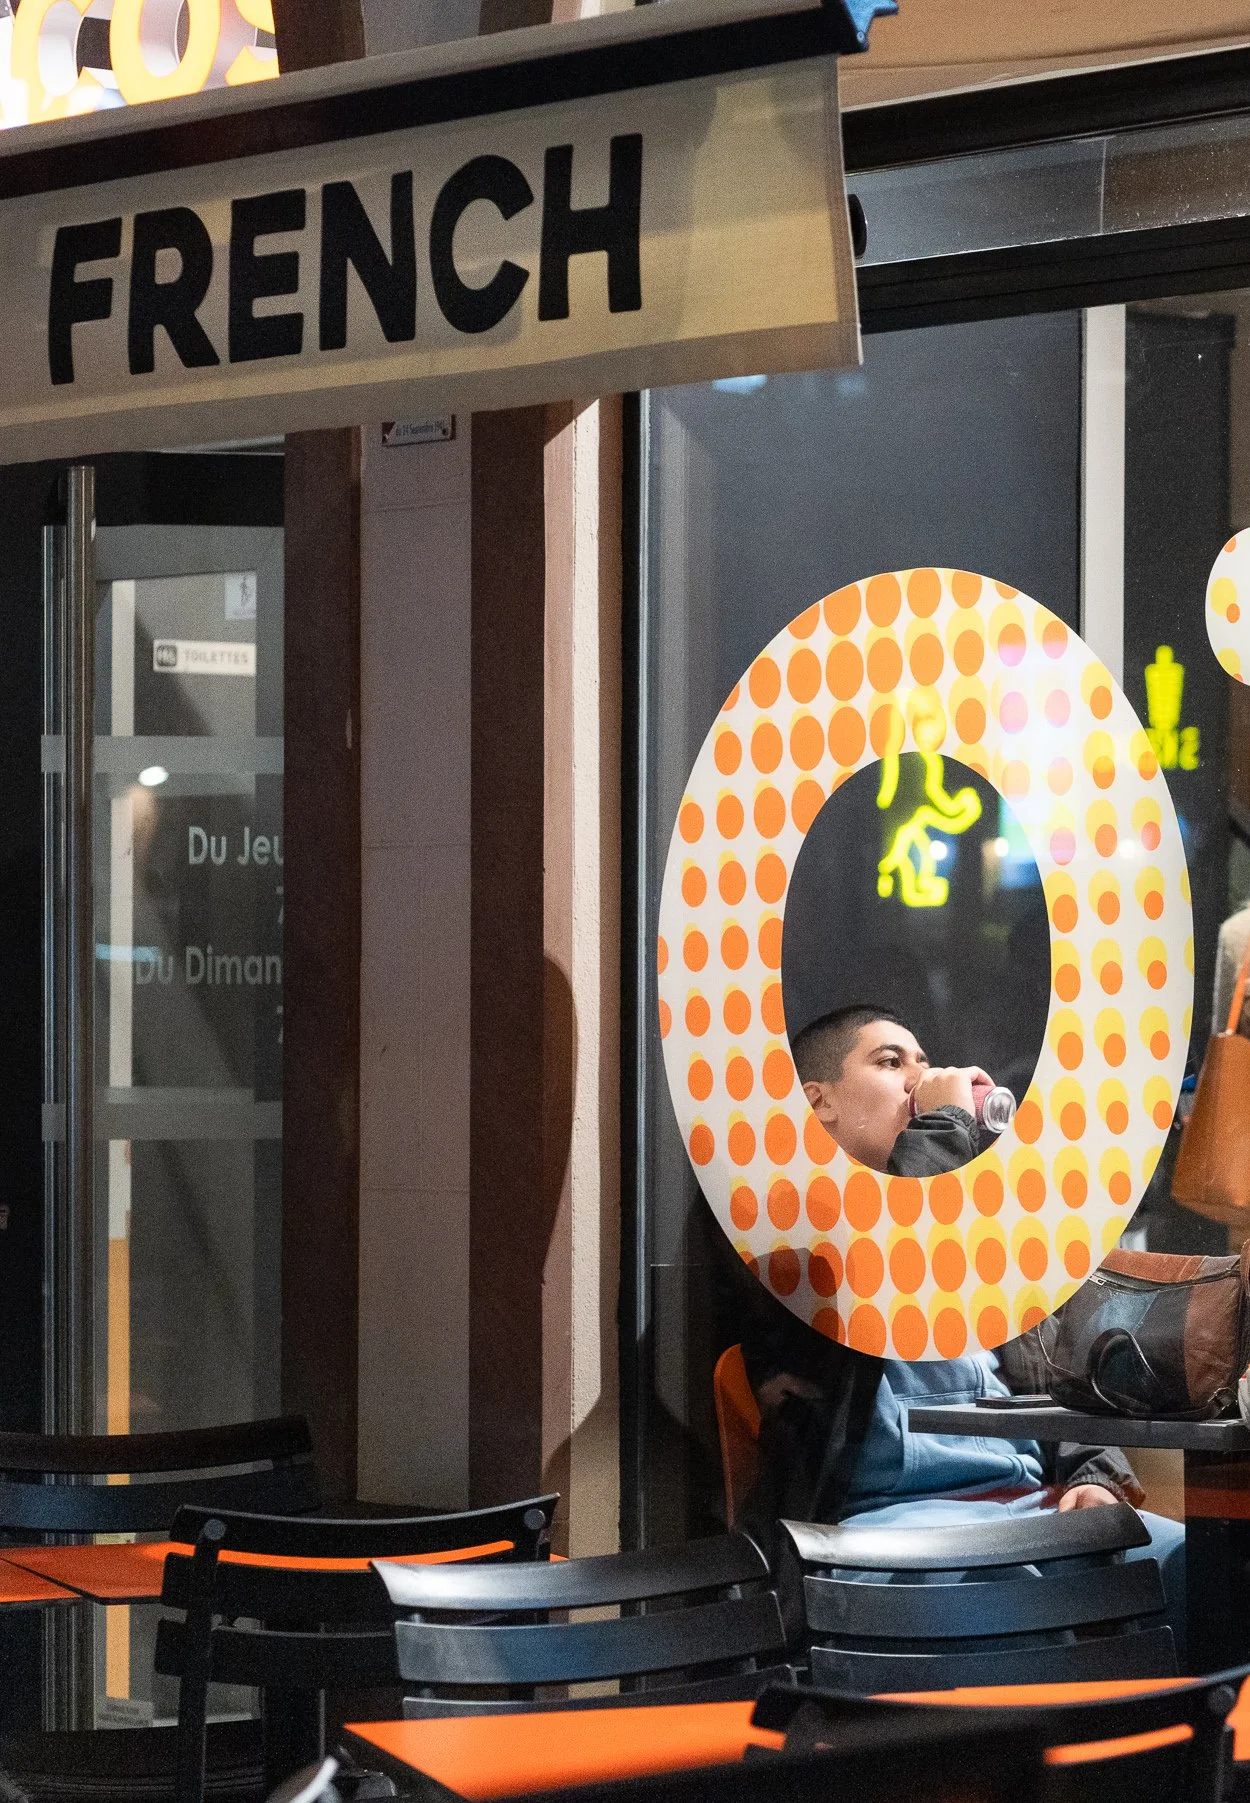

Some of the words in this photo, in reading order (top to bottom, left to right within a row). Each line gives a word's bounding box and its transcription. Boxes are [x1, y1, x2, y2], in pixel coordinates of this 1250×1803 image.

[48, 132, 644, 386] FRENCH
[188, 826, 227, 865] Du
[135, 946, 174, 985] Du
[185, 943, 282, 985] Diman
